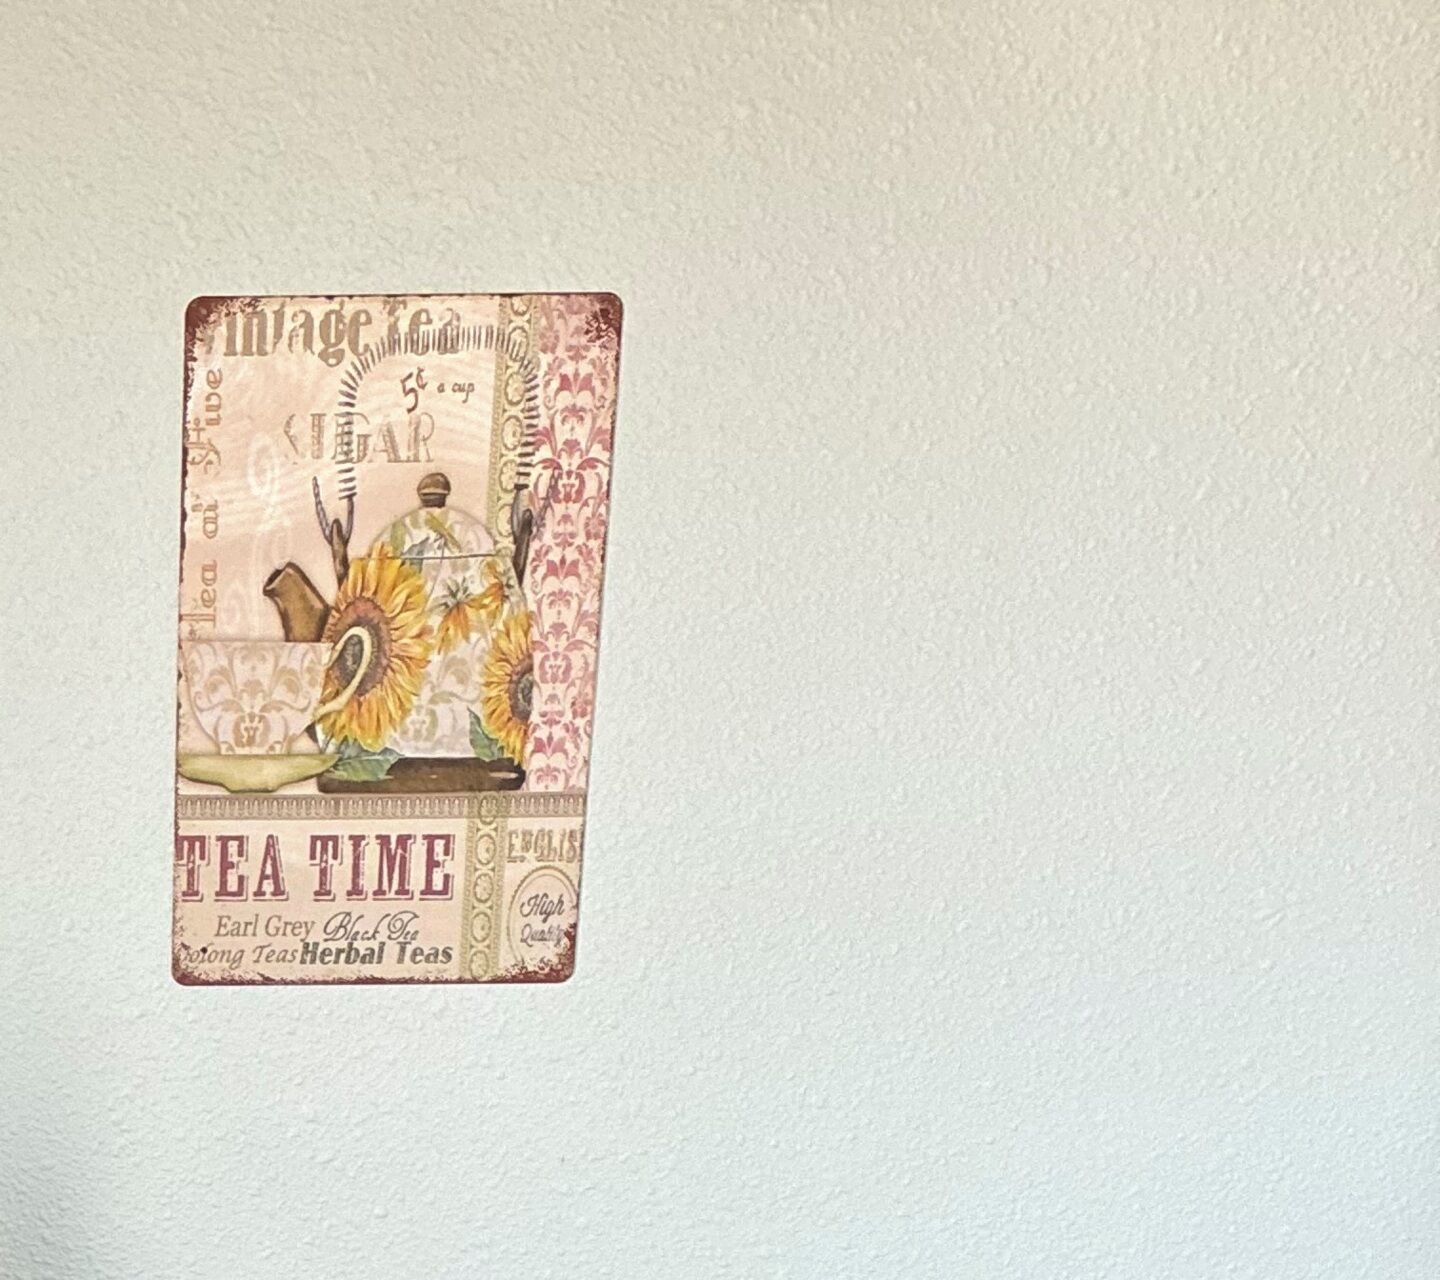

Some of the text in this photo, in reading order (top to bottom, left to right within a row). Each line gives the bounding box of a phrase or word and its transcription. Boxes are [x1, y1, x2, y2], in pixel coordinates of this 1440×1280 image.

[212, 299, 372, 367] intage
[451, 382, 475, 403] cup
[507, 829, 583, 863] ENGLIS
[175, 834, 455, 901] TEA TIME
[520, 892, 564, 923] High
[214, 911, 420, 942] Earl Grey Black Tea
[179, 942, 299, 970] olong Teas
[300, 942, 454, 966] Herbal Teas
